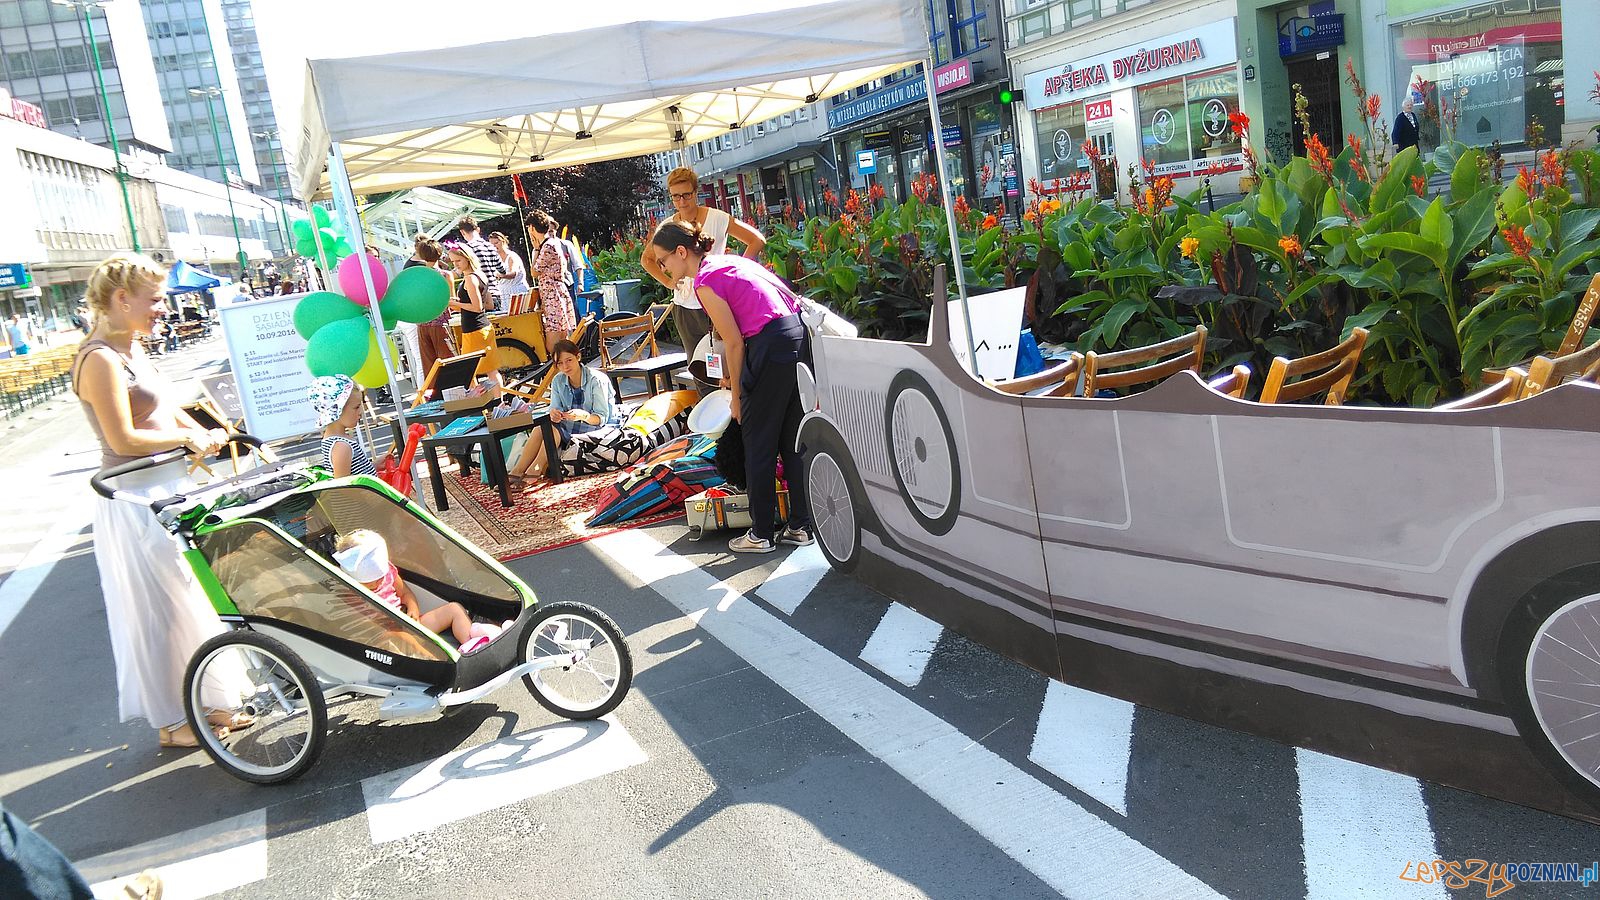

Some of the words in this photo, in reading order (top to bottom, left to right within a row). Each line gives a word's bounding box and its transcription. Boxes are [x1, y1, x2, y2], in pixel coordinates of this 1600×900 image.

[1044, 64, 1106, 96] APTEKA
[1112, 38, 1203, 79] DYŻURNA
[1440, 61, 1456, 73] DO
[1459, 47, 1522, 70] WYNAJĘCIA
[1457, 75, 1477, 88] 666
[1480, 71, 1499, 85] 173
[1502, 66, 1524, 80] 192
[857, 98, 876, 116] SZKOŁA
[906, 79, 927, 99] OBCYC
[1088, 104, 1102, 119] 24
[1103, 103, 1111, 116] h
[256, 328, 296, 341] 10.09.2016
[364, 649, 393, 666] THULE
